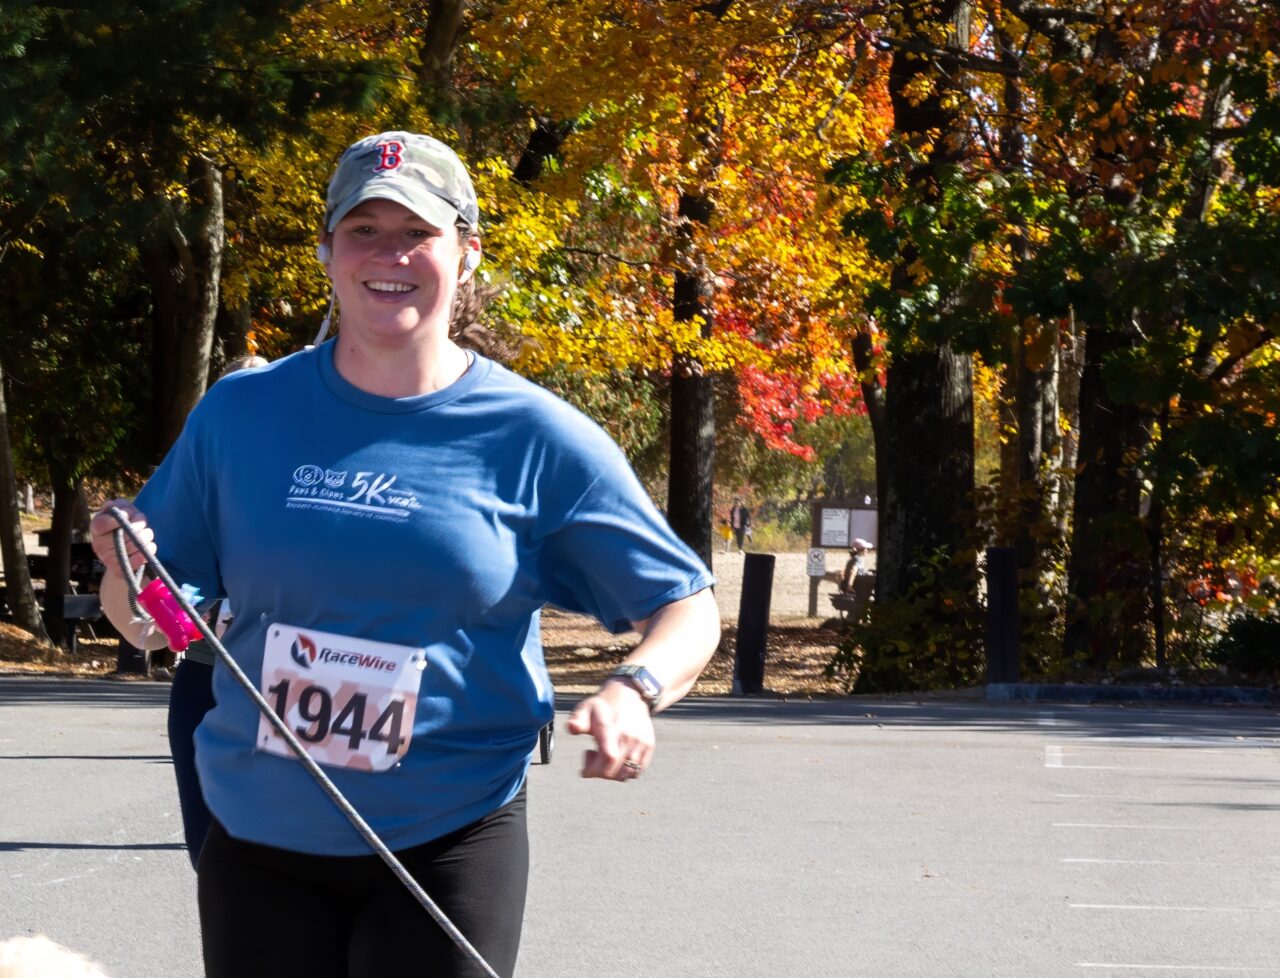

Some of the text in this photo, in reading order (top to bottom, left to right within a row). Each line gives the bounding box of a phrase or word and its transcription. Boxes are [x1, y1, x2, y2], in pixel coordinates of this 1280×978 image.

[373, 140, 404, 172] B
[347, 471, 397, 506] 5K
[318, 647, 397, 672] RaceWire
[268, 678, 406, 755] 1944
